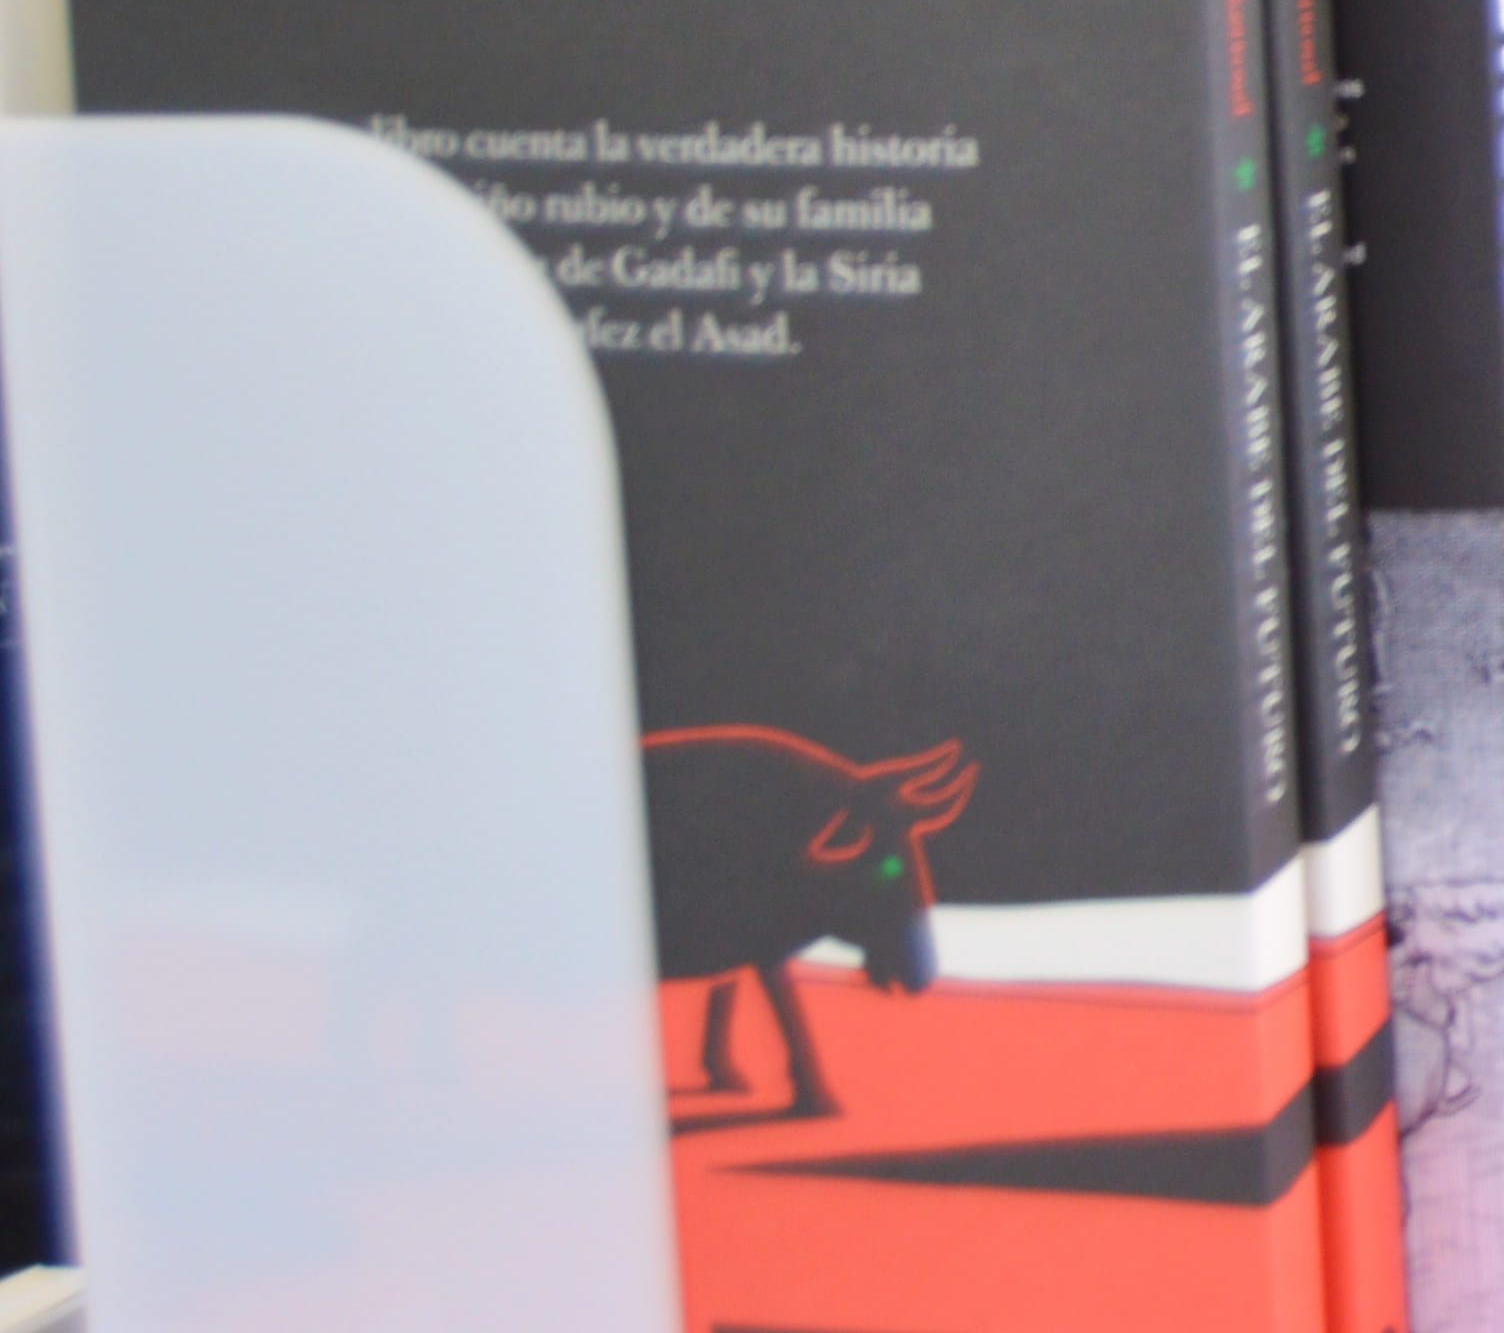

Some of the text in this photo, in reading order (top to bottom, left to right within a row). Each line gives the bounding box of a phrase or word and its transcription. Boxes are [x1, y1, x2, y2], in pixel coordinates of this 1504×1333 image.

[465, 128, 587, 162] cuenta
[595, 119, 628, 162] la
[638, 122, 821, 167] verdadera
[830, 123, 979, 168] historia
[543, 182, 932, 239] rubio y de su familia
[557, 244, 922, 304] de Gadafi y la Siria
[647, 311, 801, 356] el Asad.
